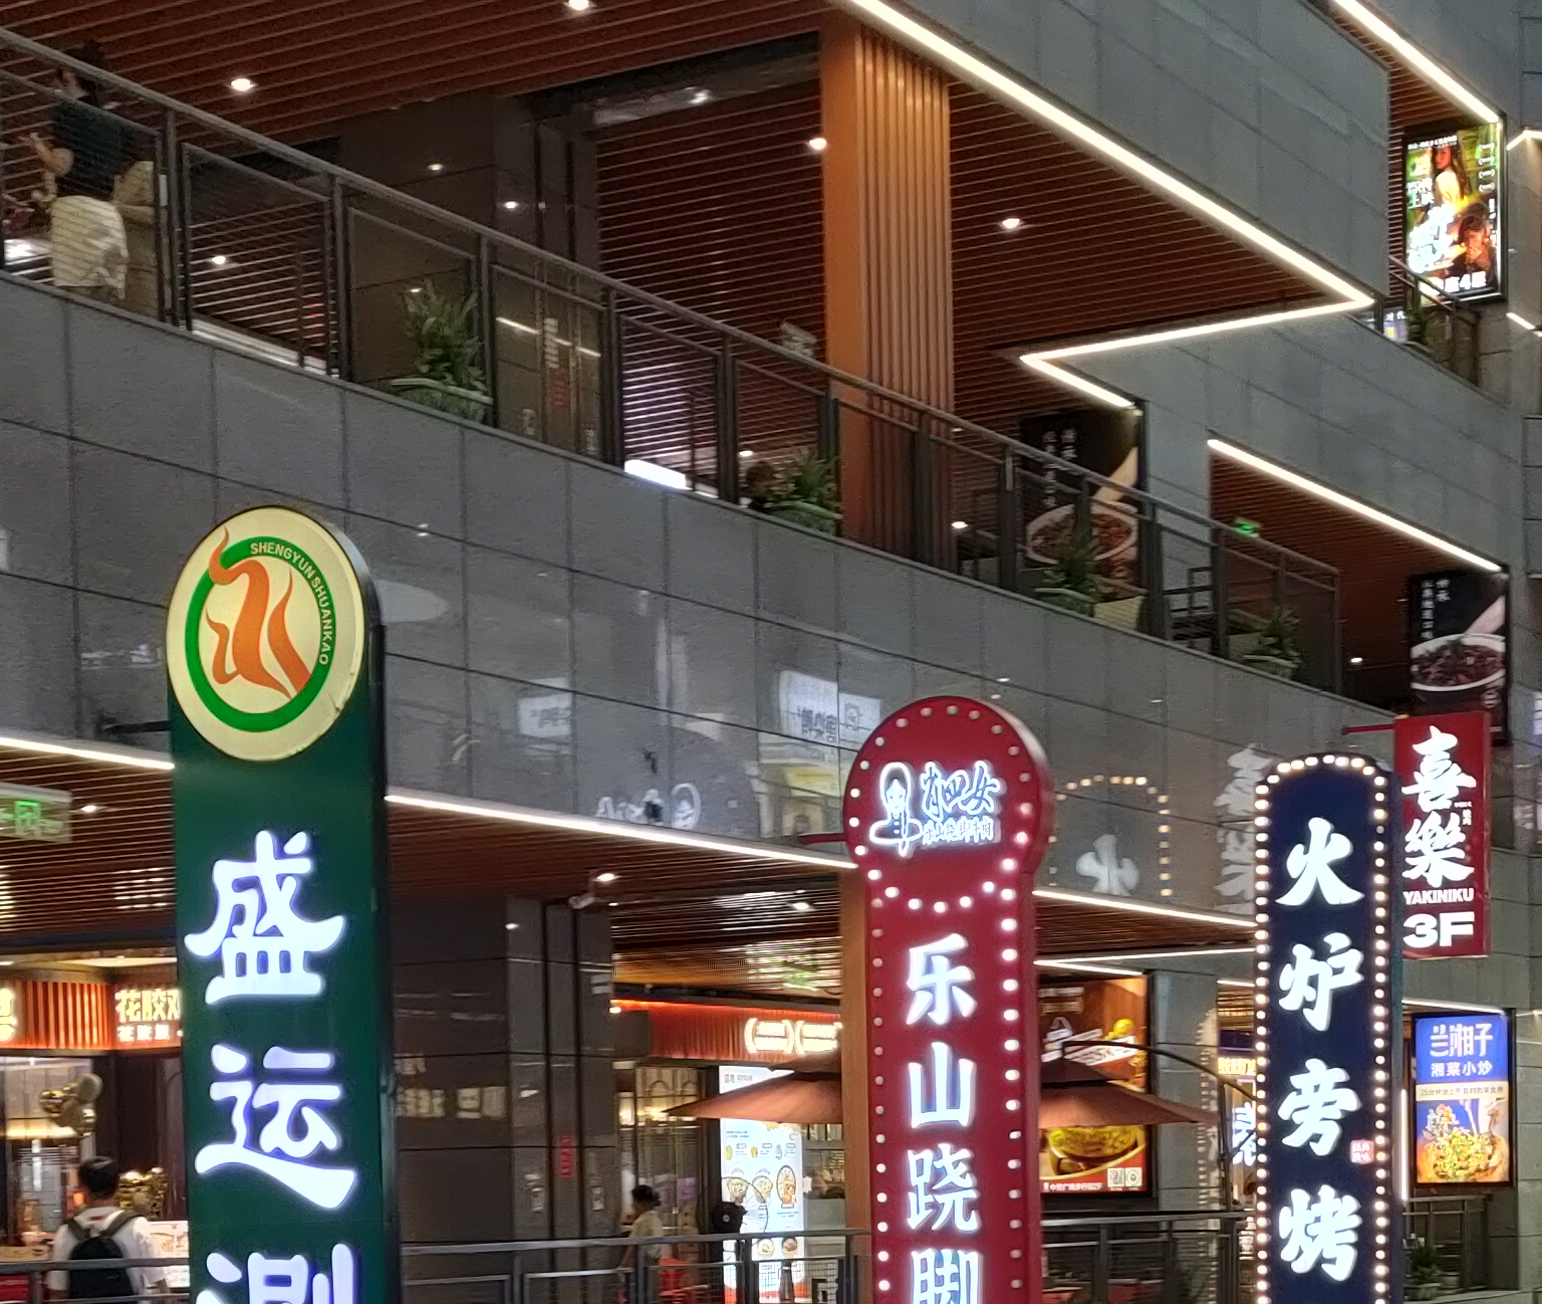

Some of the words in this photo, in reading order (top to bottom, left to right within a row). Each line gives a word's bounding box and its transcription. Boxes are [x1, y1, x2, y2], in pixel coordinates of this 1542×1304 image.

[250, 542, 315, 579] SHENGYUN
[311, 577, 332, 665] SHUANKAO
[1403, 888, 1474, 905] YAKINIKU
[1403, 911, 1475, 948] 3F
[1431, 1061, 1493, 1077] 湘菜小炒
